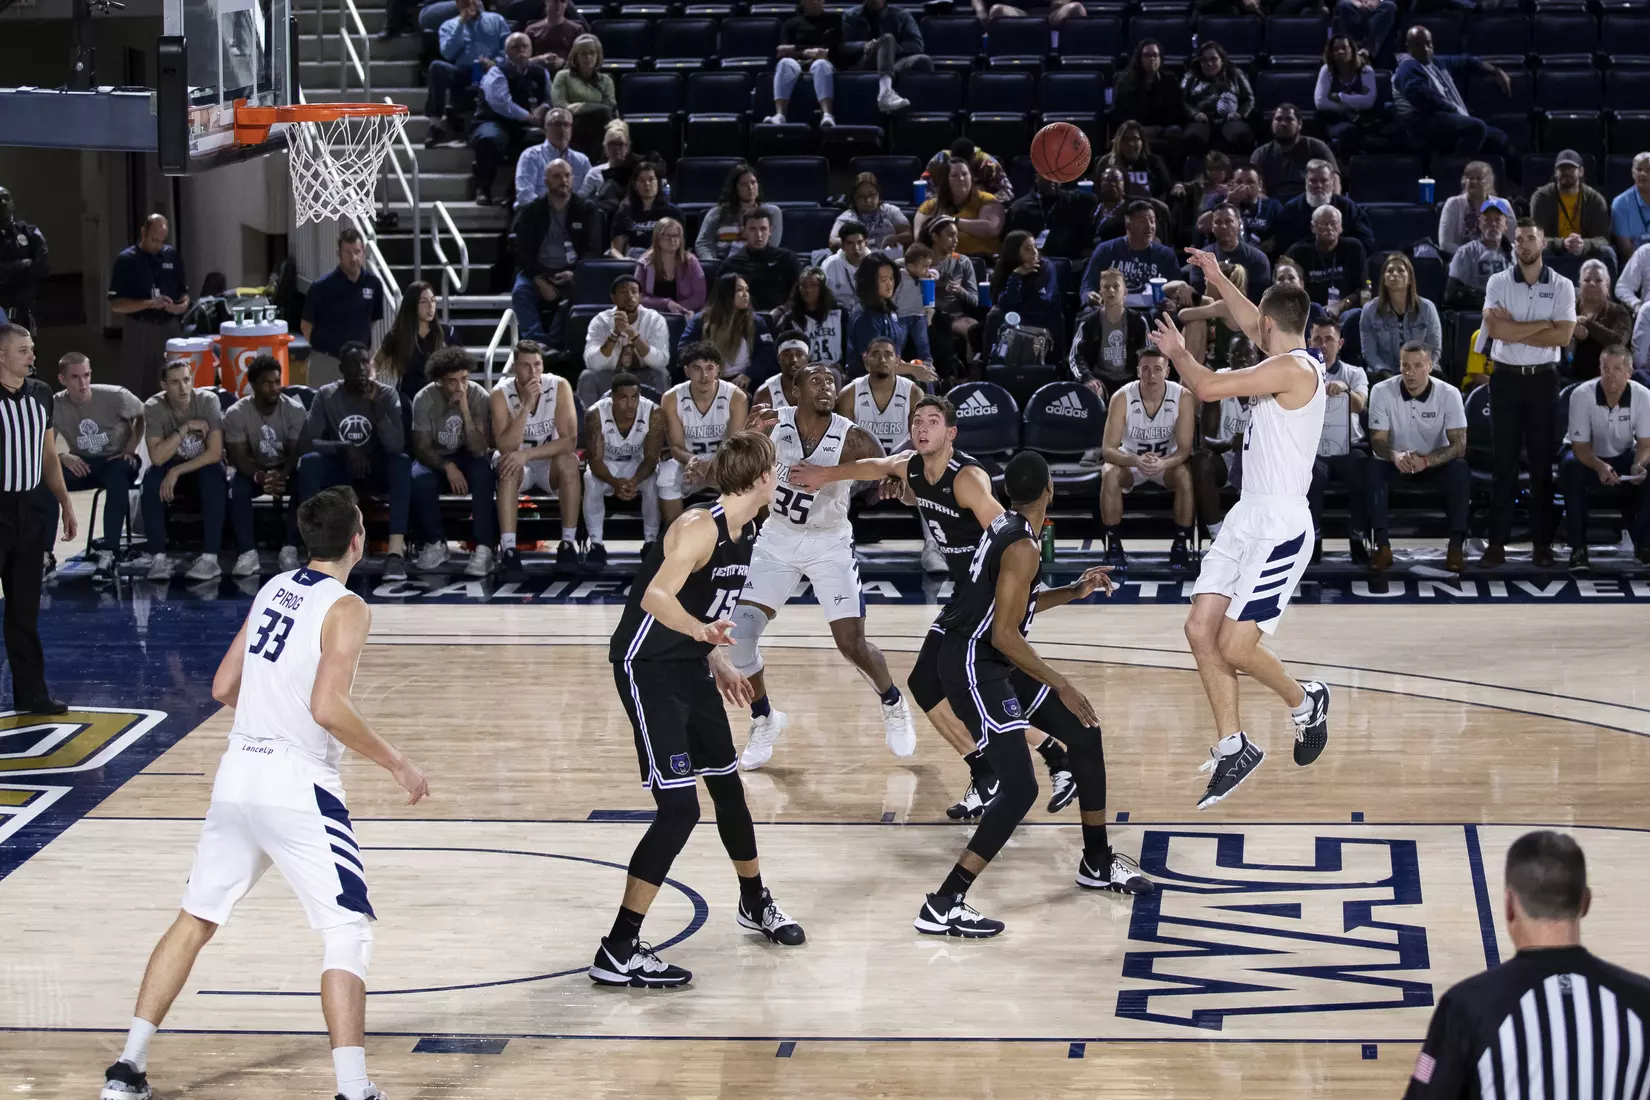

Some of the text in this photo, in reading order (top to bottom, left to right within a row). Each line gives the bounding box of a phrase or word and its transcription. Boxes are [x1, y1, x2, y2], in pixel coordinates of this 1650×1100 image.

[956, 405, 998, 418] adidas
[1045, 405, 1088, 418] adidas
[685, 425, 726, 439] LANCERS
[860, 420, 903, 435] LANCERS
[1131, 426, 1173, 440] LANCERS
[773, 485, 815, 525] 35
[915, 497, 960, 518] ENTRAL
[928, 520, 948, 544] 3
[711, 564, 751, 580] CENTRA
[272, 587, 304, 611] PIROG
[705, 588, 741, 621] 15
[248, 607, 295, 663] 33
[241, 744, 275, 756] LanceUp
[1114, 830, 1435, 1031] WAC
